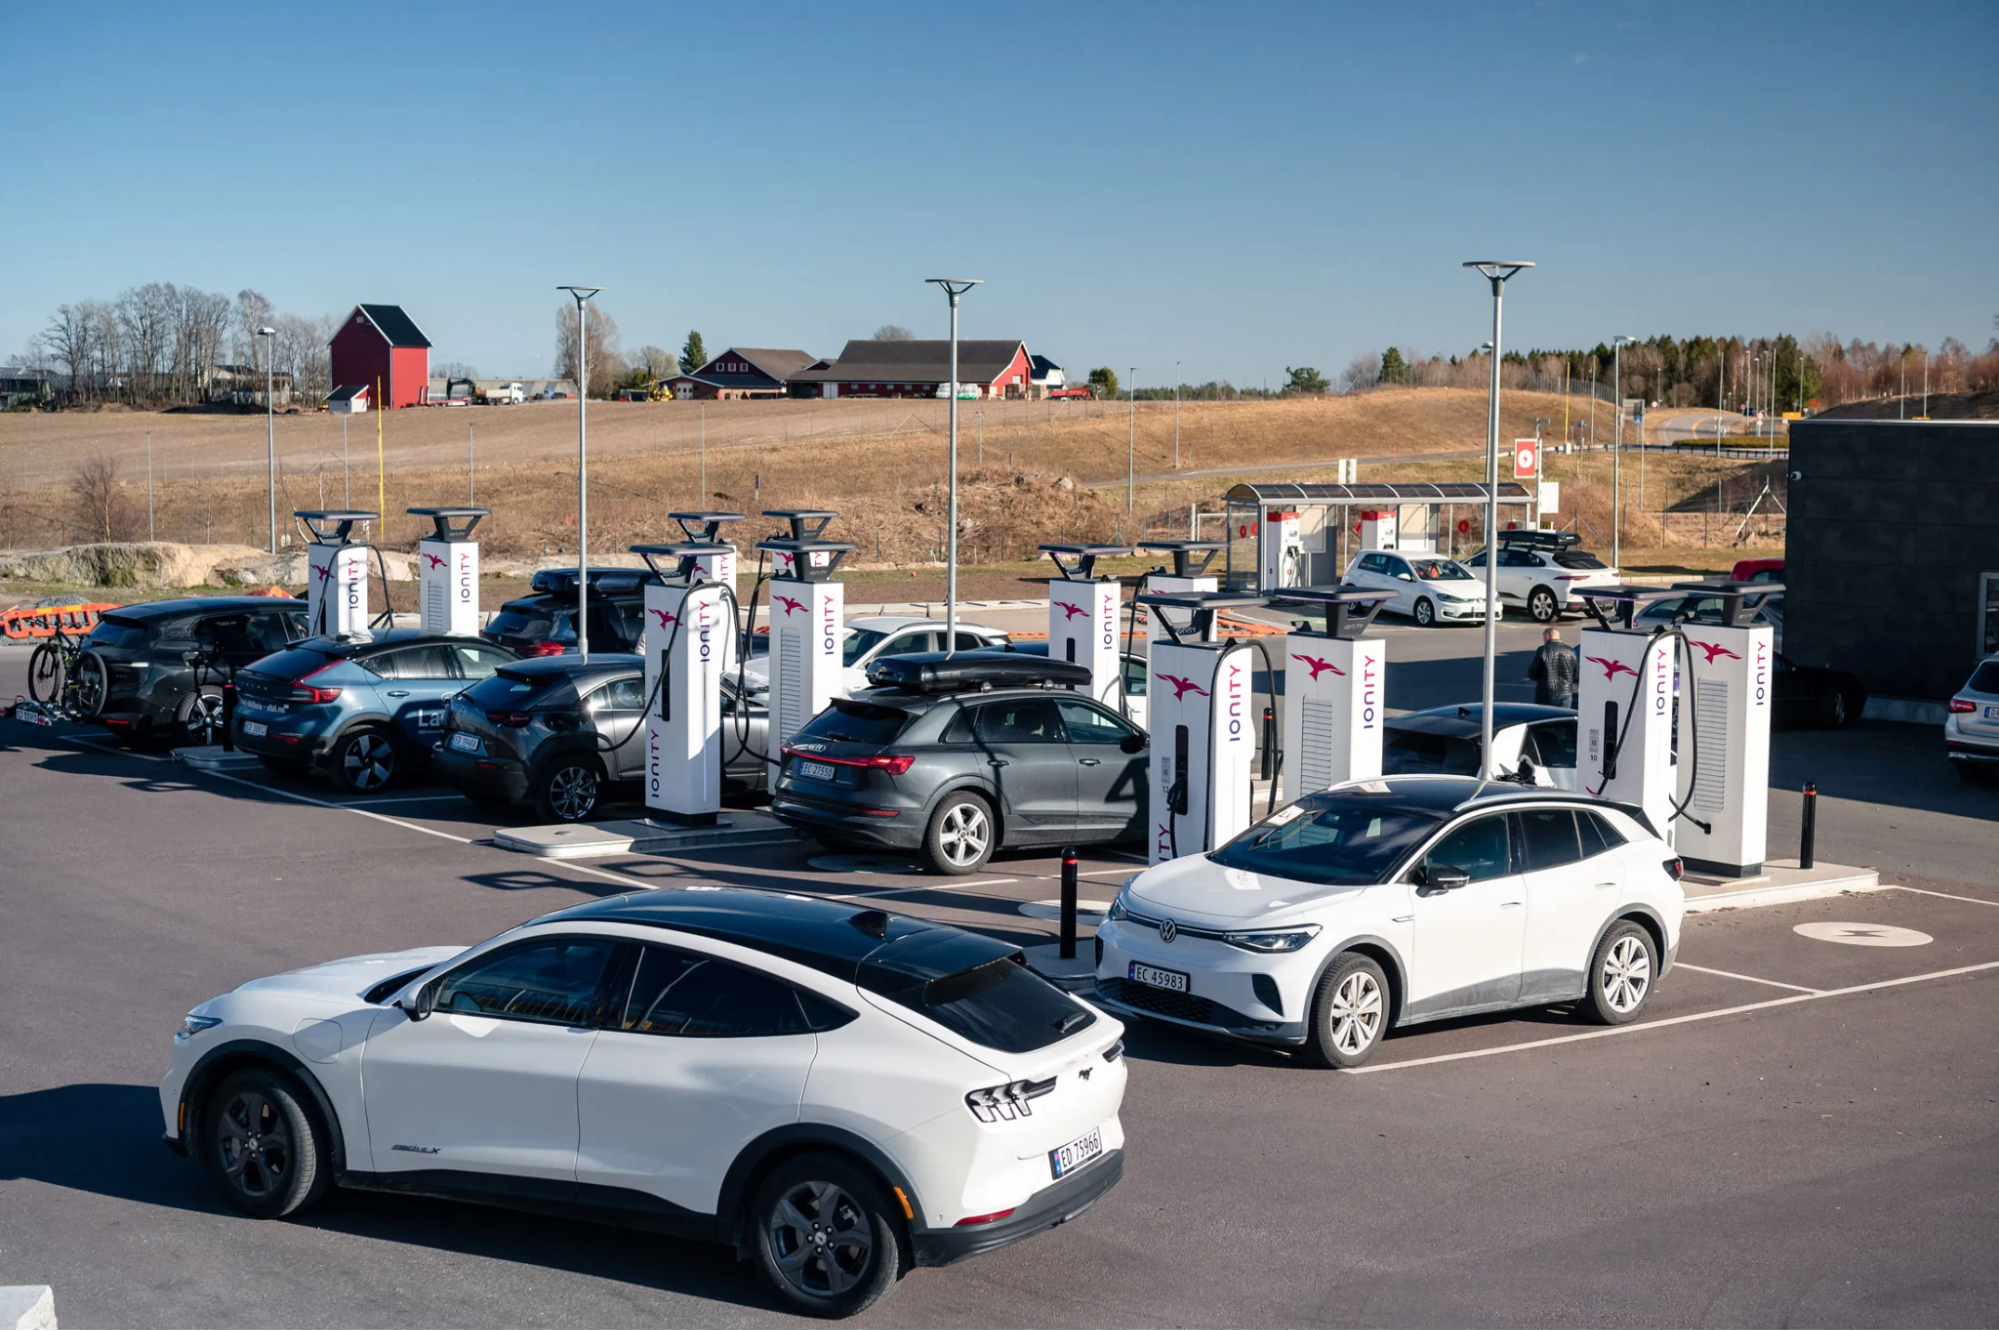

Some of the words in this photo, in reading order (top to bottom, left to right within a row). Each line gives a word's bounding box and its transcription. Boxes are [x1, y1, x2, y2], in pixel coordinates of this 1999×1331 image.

[348, 557, 358, 609] IONITY
[460, 552, 470, 603] IONITY
[699, 600, 711, 662] IONITY
[824, 595, 834, 655] IONITY
[1103, 594, 1113, 650] IONITY
[1229, 664, 1242, 742] IONITY
[1363, 655, 1375, 730] IONITY
[1656, 648, 1667, 716] IONITY
[1755, 641, 1766, 706] IONITY
[650, 729, 660, 798] IONITY
[803, 763, 812, 774] EC
[814, 765, 832, 777] 27550
[1136, 966, 1148, 982] EC
[1151, 971, 1183, 990] 45983
[1061, 1147, 1073, 1168] ED
[1074, 1132, 1099, 1161] 75966
